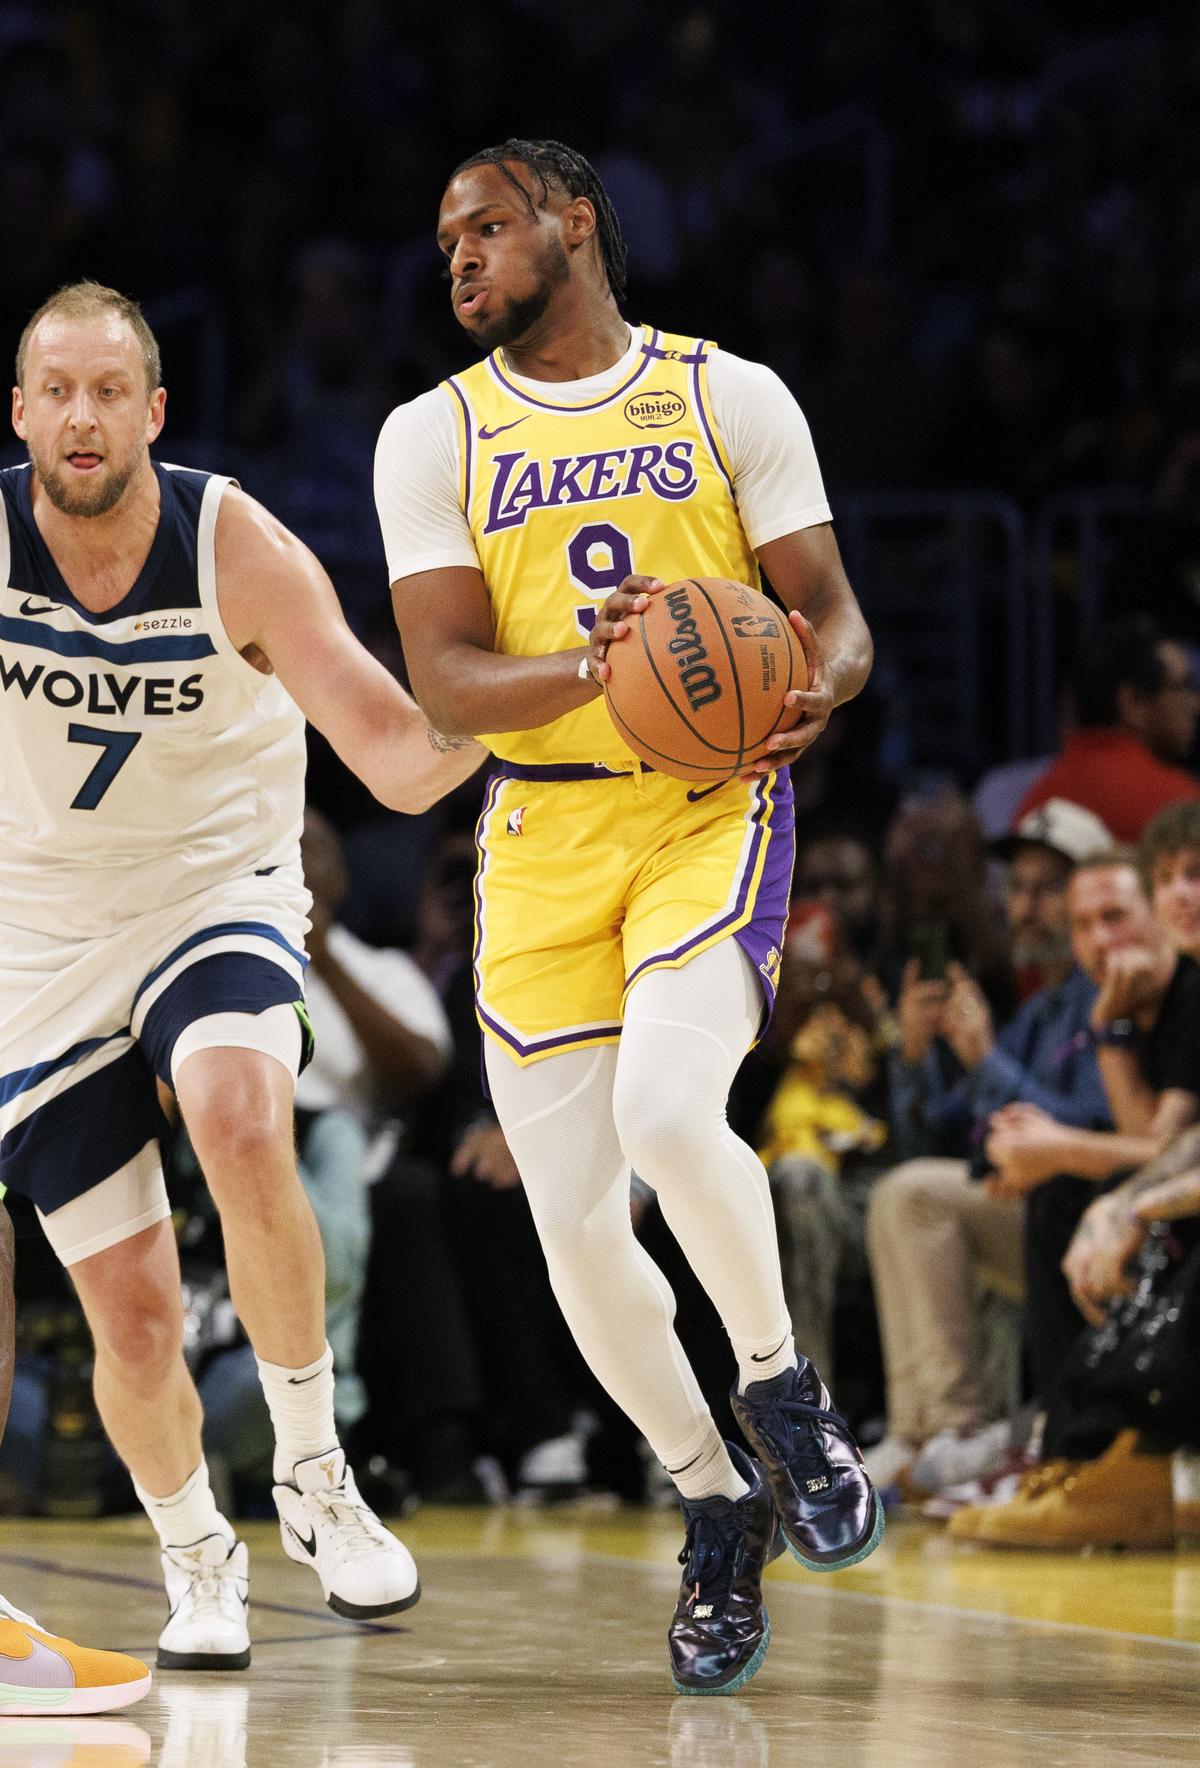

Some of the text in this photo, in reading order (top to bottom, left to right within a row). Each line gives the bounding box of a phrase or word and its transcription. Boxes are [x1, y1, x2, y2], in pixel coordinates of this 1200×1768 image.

[629, 401, 682, 416] bibigo
[482, 441, 699, 537] LAKERS
[143, 615, 192, 630] sezzle
[566, 520, 634, 642] 9
[664, 587, 723, 713] Wilson
[67, 723, 142, 810] 7
